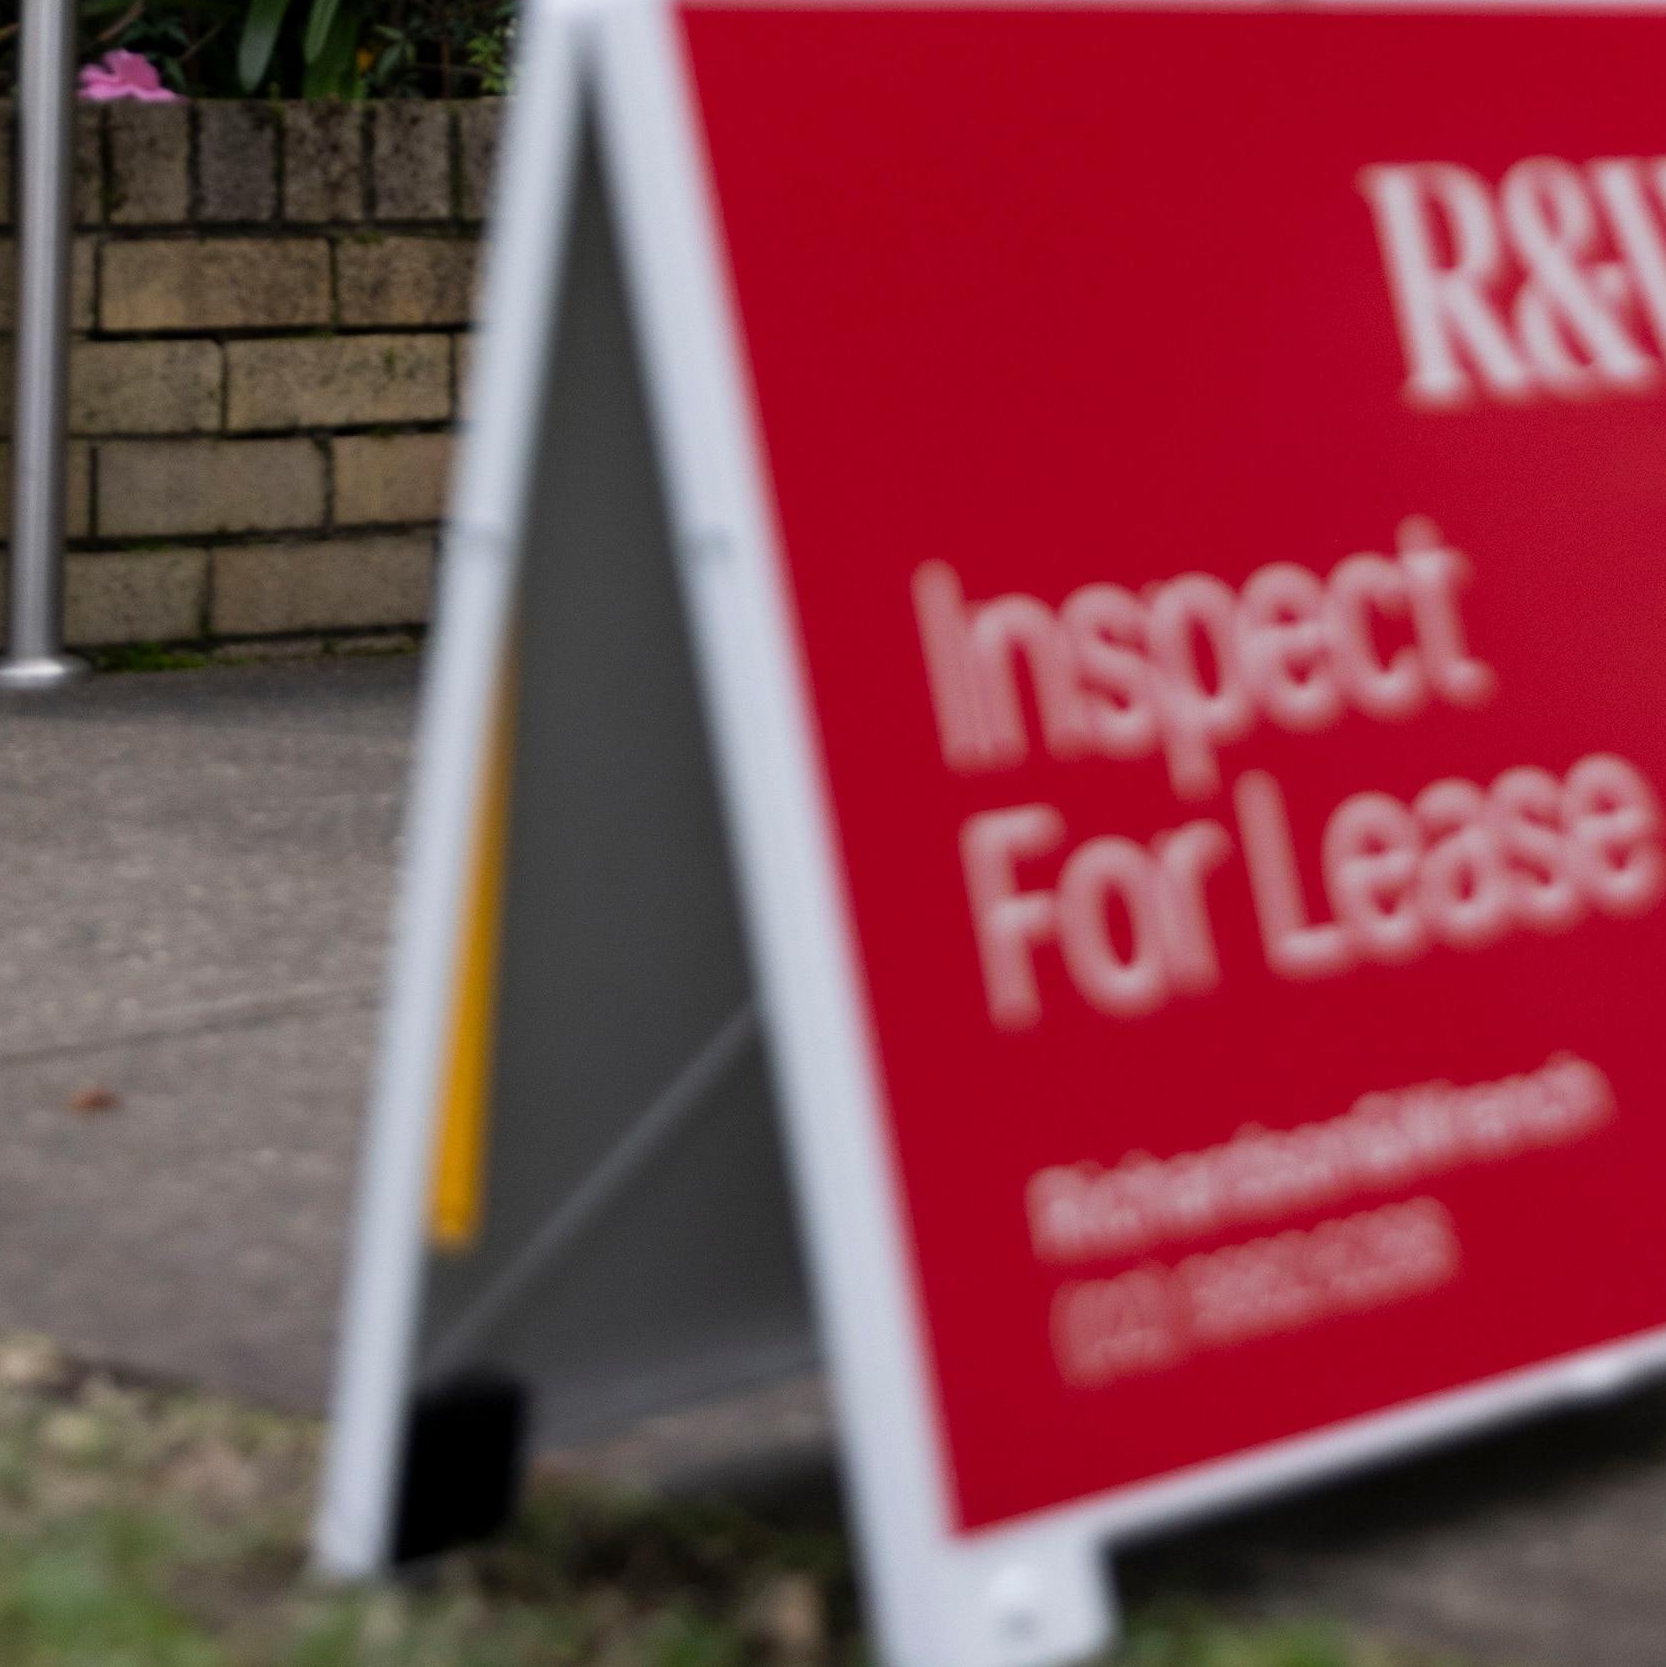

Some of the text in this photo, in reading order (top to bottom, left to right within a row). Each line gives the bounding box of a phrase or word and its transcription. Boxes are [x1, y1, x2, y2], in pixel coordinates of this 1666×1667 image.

[913, 517, 1495, 798] Inspect
[960, 753, 1666, 1027] For Lease
